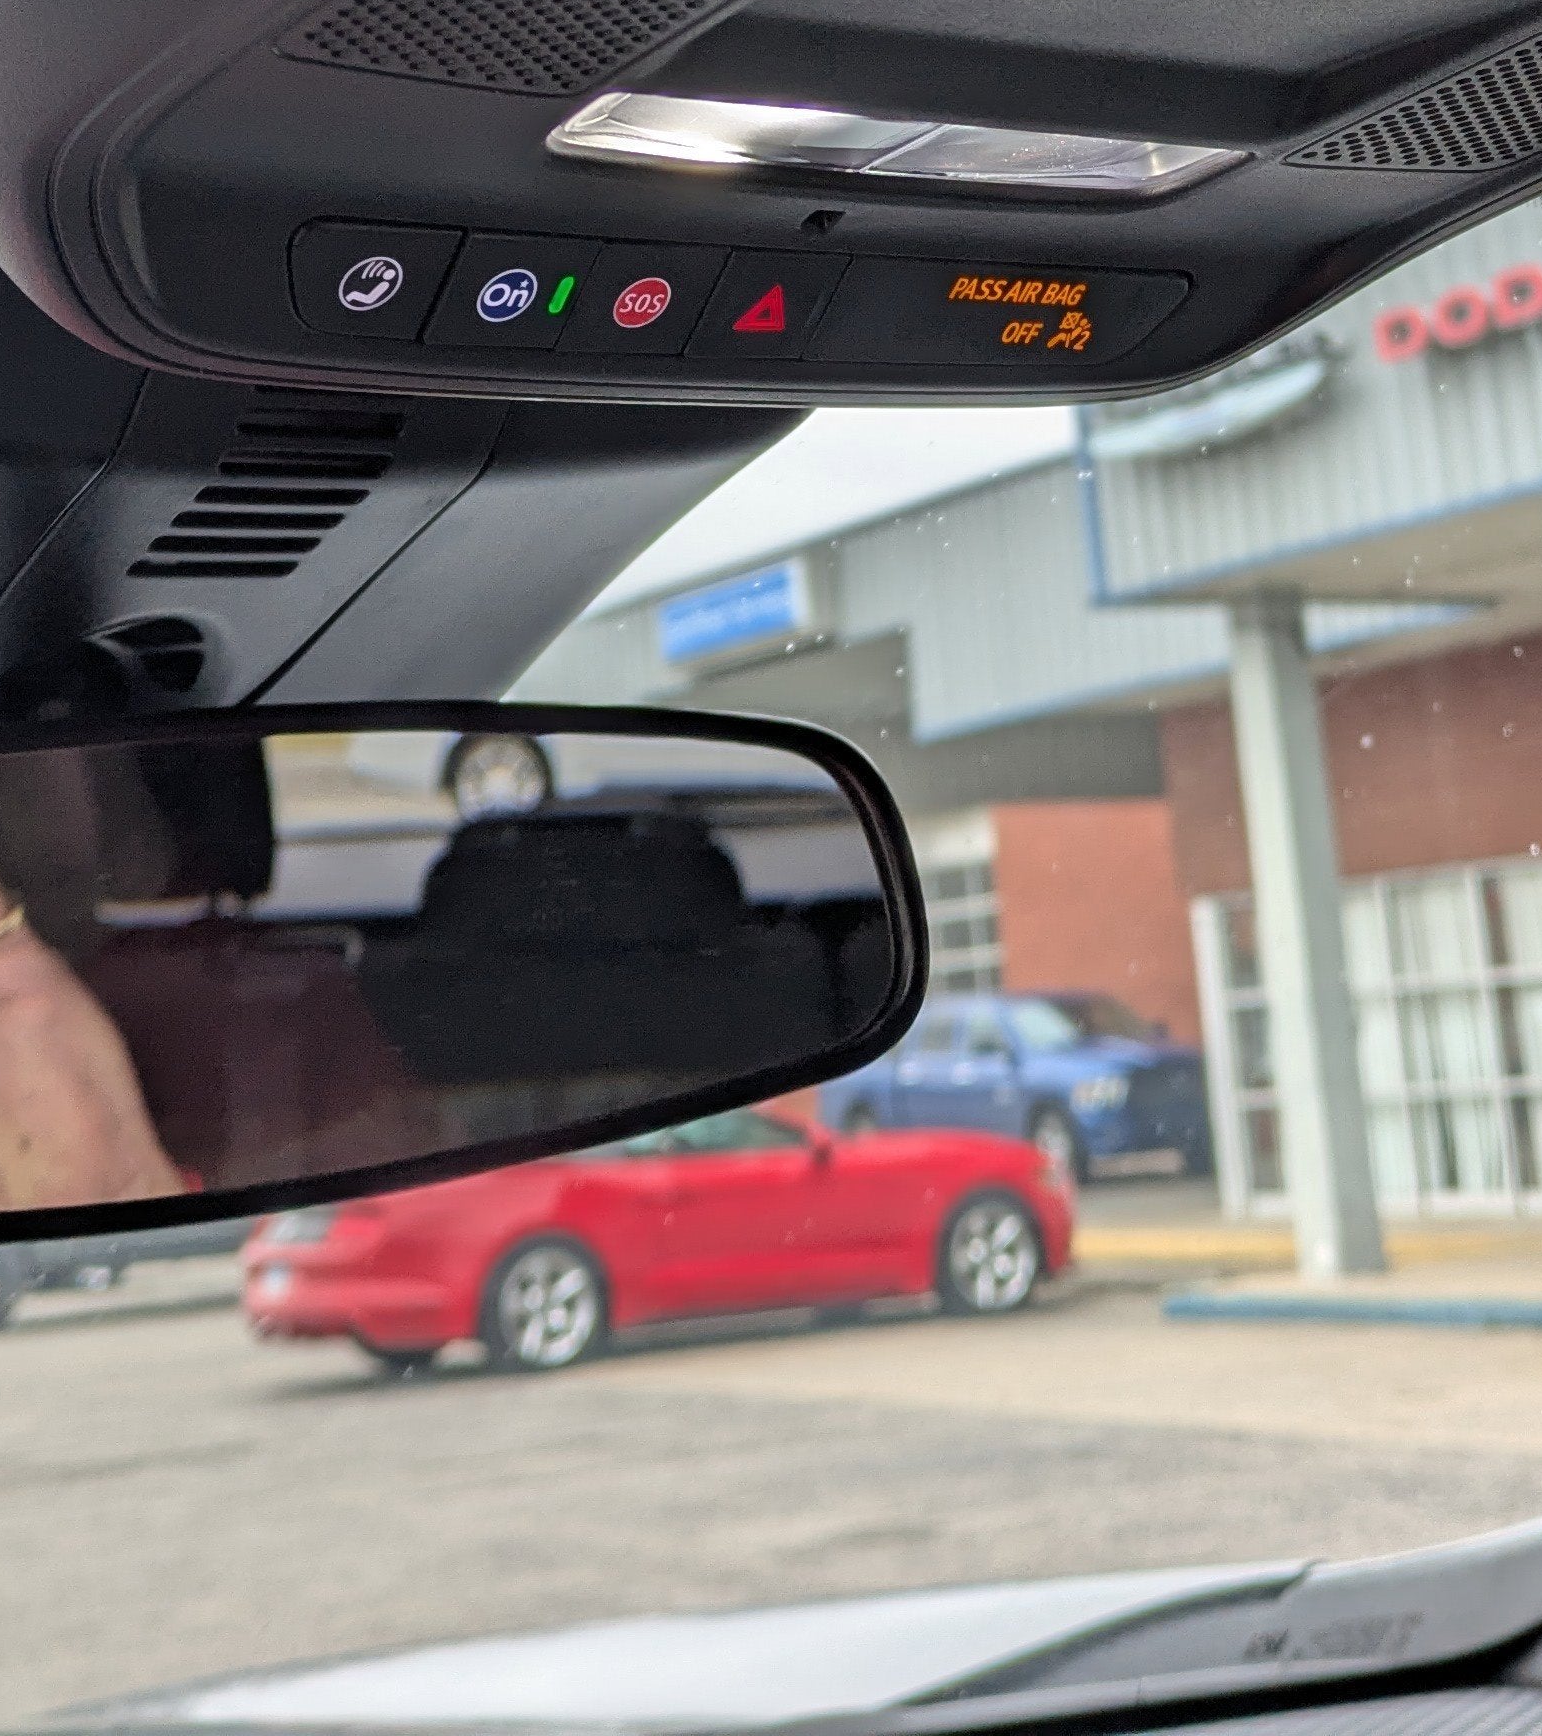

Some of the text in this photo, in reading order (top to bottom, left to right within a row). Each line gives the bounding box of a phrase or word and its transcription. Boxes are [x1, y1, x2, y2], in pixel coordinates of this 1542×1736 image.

[483, 282, 529, 307] On
[948, 277, 1086, 306] PASS AIR BAG
[619, 293, 665, 314] SOS
[1001, 322, 1044, 344] OFF
